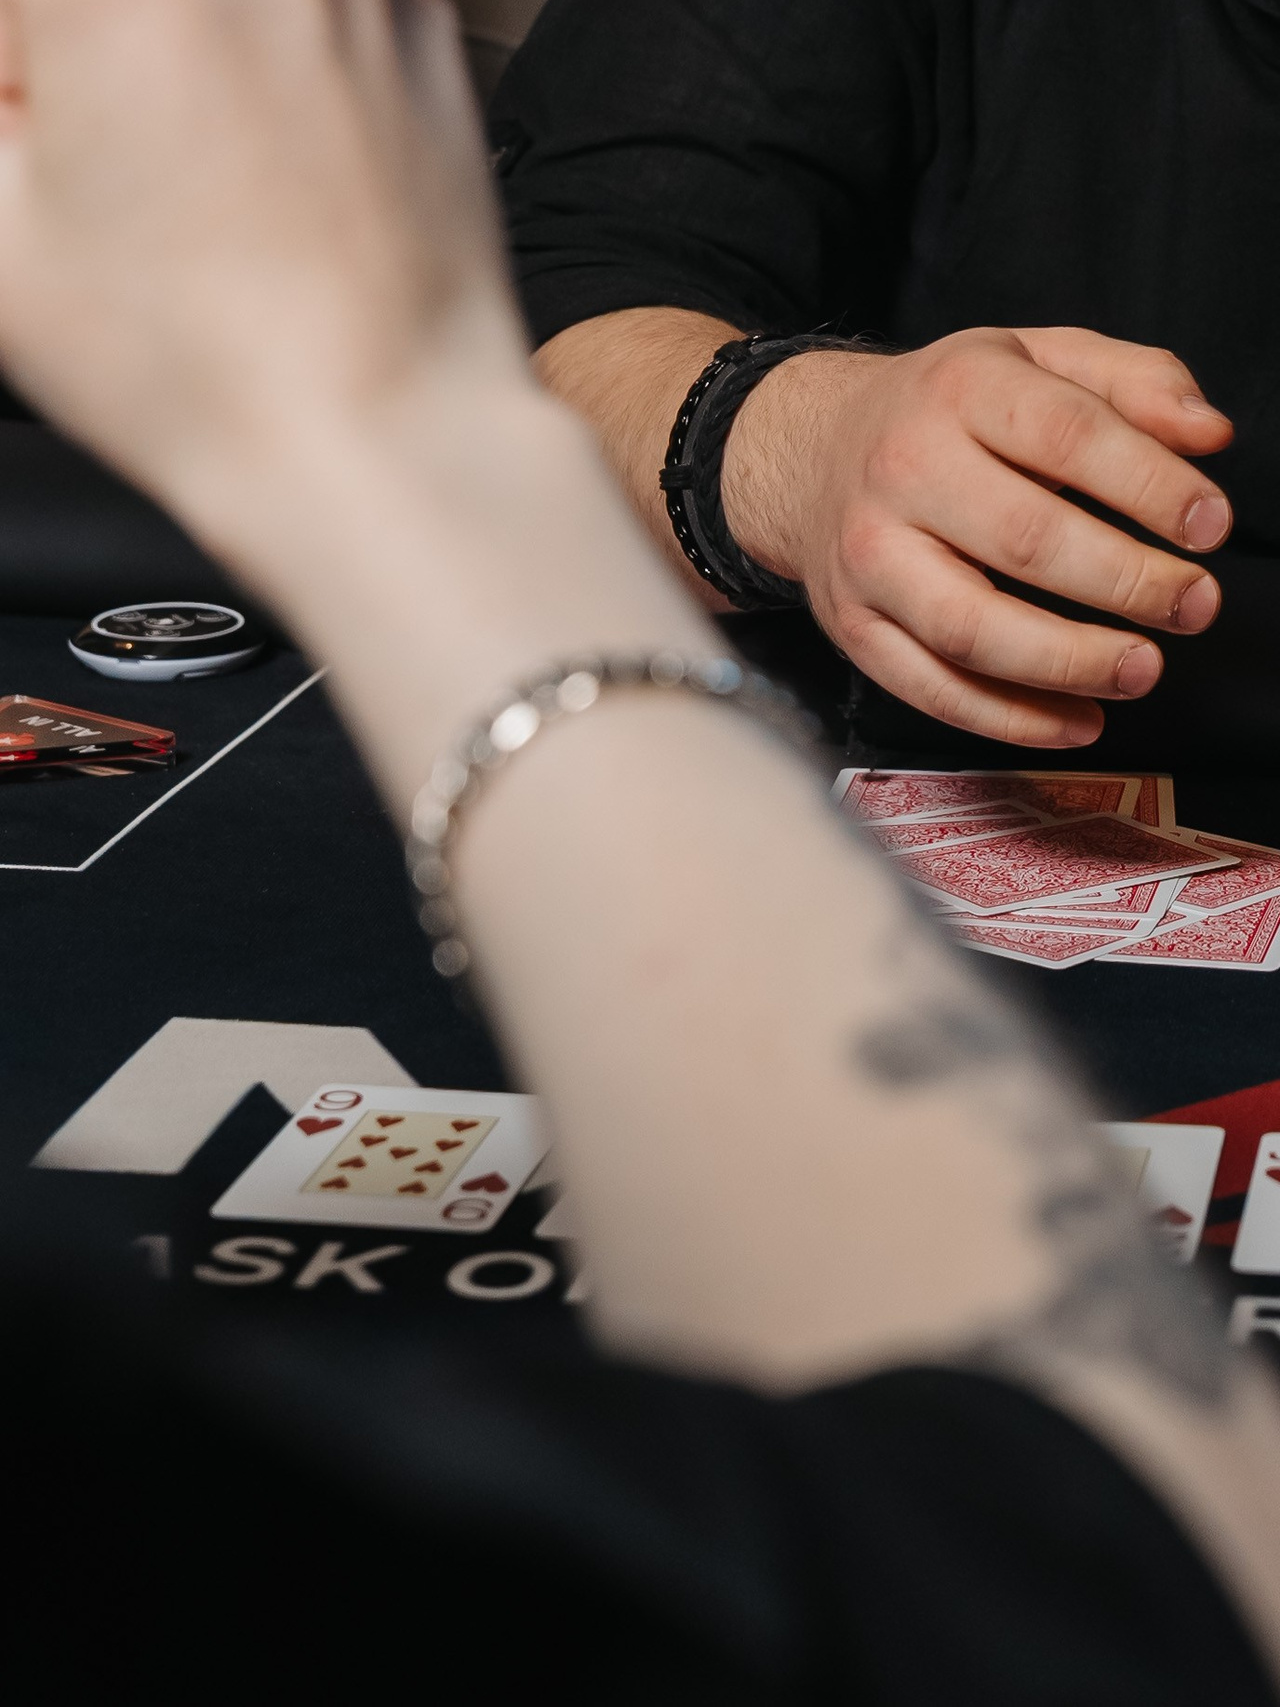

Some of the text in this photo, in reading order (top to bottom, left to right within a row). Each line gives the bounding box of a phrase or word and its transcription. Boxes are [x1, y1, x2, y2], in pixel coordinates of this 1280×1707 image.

[18, 715, 103, 738] ALL IN
[314, 1089, 364, 1112] 9
